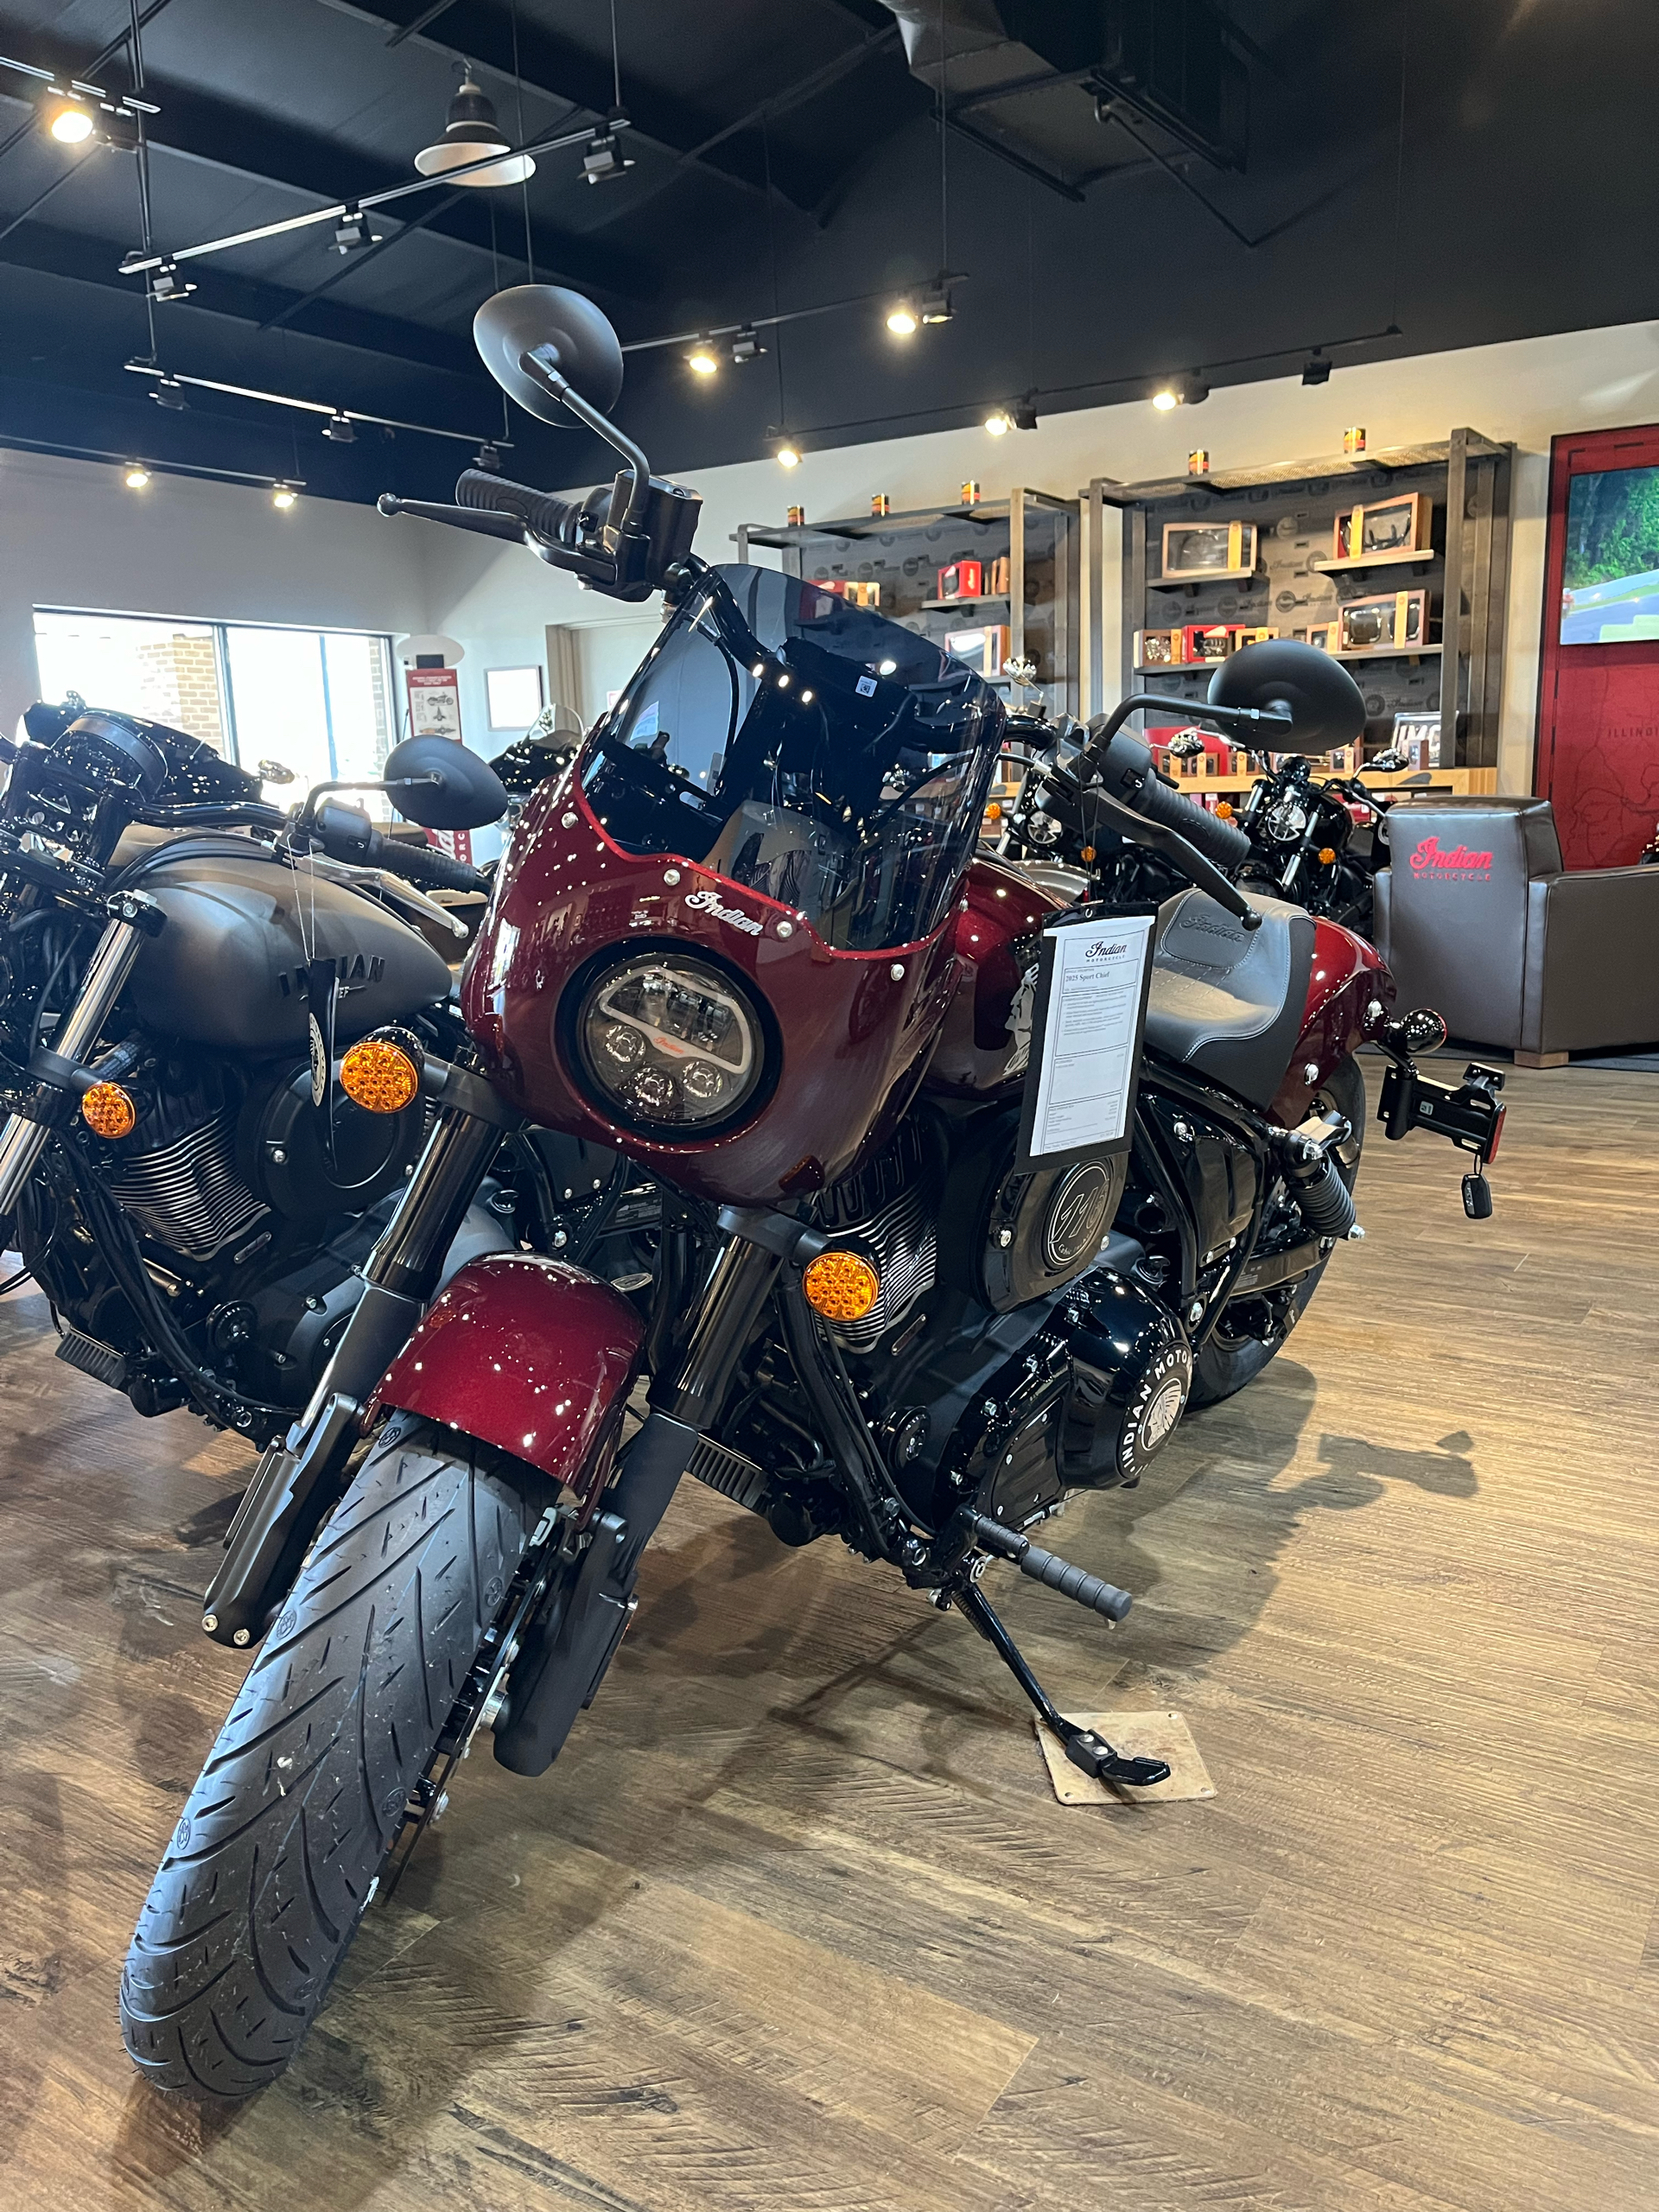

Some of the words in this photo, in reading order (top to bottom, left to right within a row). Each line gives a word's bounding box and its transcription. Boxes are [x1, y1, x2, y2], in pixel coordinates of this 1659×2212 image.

[1607, 726, 1659, 738] ILLINOI
[1409, 836, 1493, 870] Indian
[1414, 872, 1491, 881] MOTORCYCLE
[685, 891, 764, 936] Indian
[1179, 913, 1245, 943] Indian
[1085, 941, 1128, 957] Indian
[1079, 973, 1095, 982] Sport
[653, 1037, 684, 1054] Indian
[1122, 1384, 1152, 1468] INDIAN
